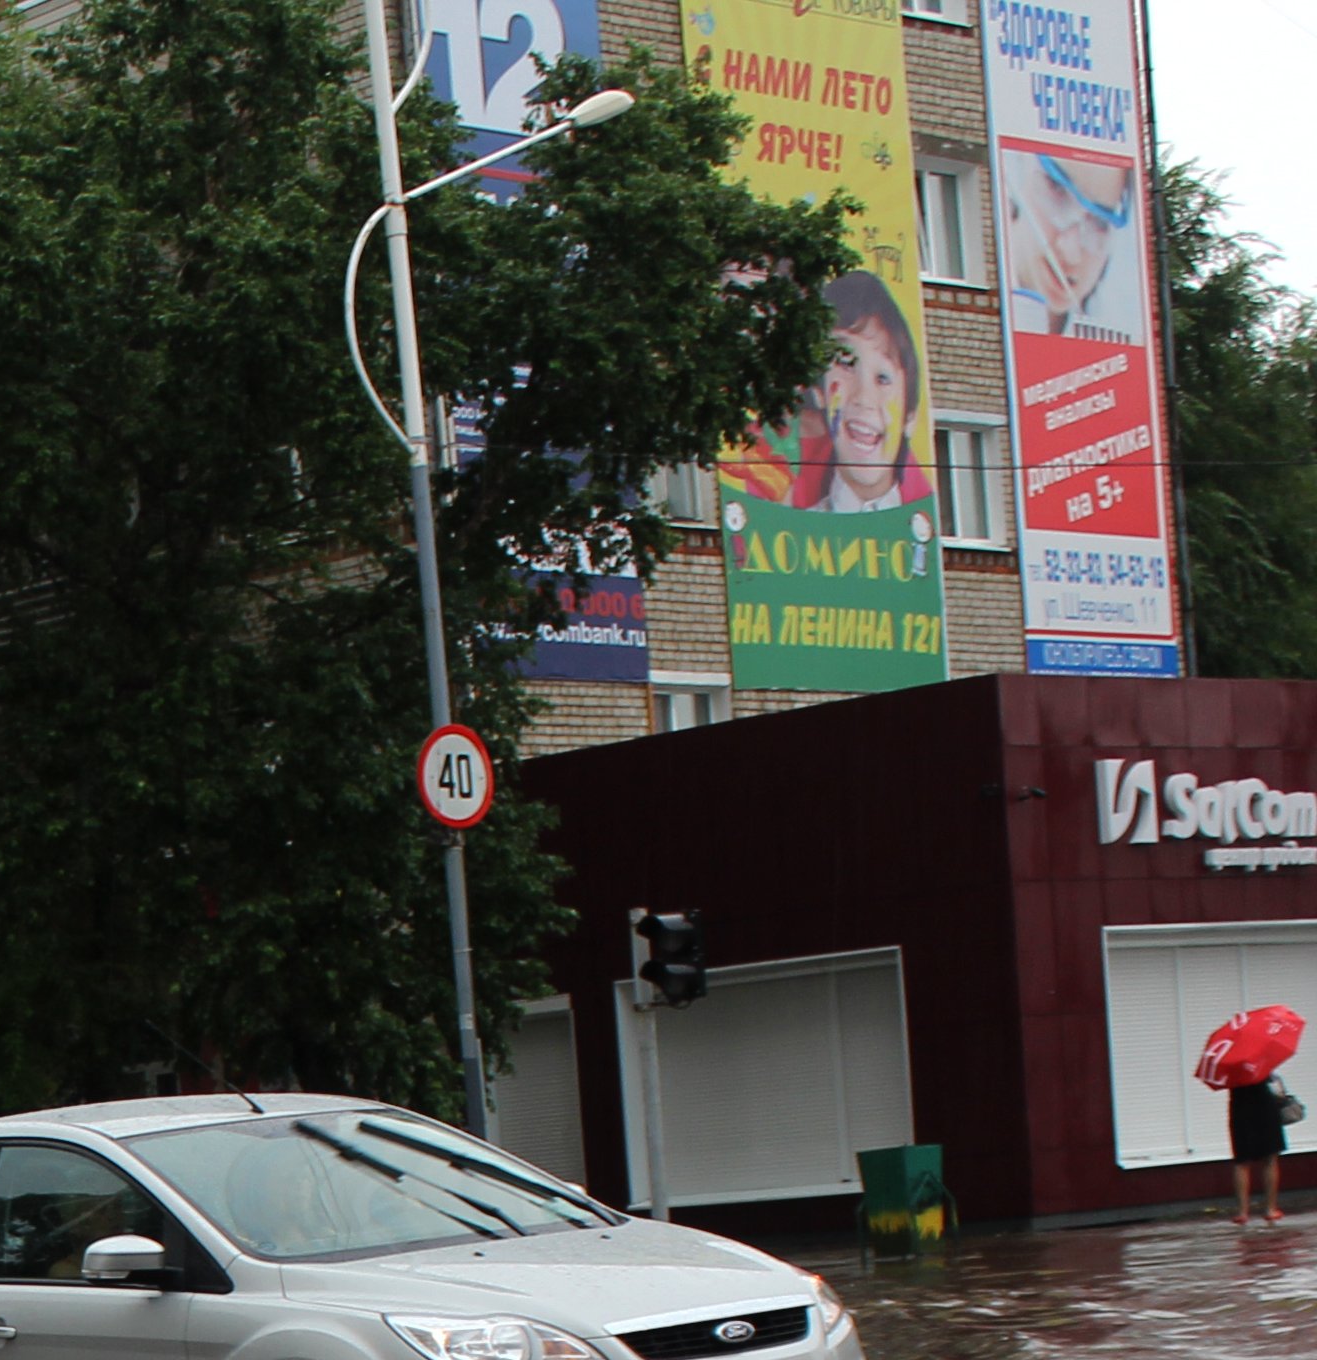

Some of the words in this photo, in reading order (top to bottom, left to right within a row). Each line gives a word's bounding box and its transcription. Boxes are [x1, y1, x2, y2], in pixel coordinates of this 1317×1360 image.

[723, 48, 812, 102] НАМИ
[821, 66, 893, 116] ЛЕТО
[756, 122, 844, 174] ЯРЧЕ!
[1066, 492, 1094, 523] на
[1095, 475, 1125, 510] 5+
[741, 530, 916, 583] ДОМИНО
[732, 603, 772, 645] НА
[779, 604, 895, 651] ЛЕНИНА
[902, 612, 942, 656] 121
[438, 753, 474, 799] 40
